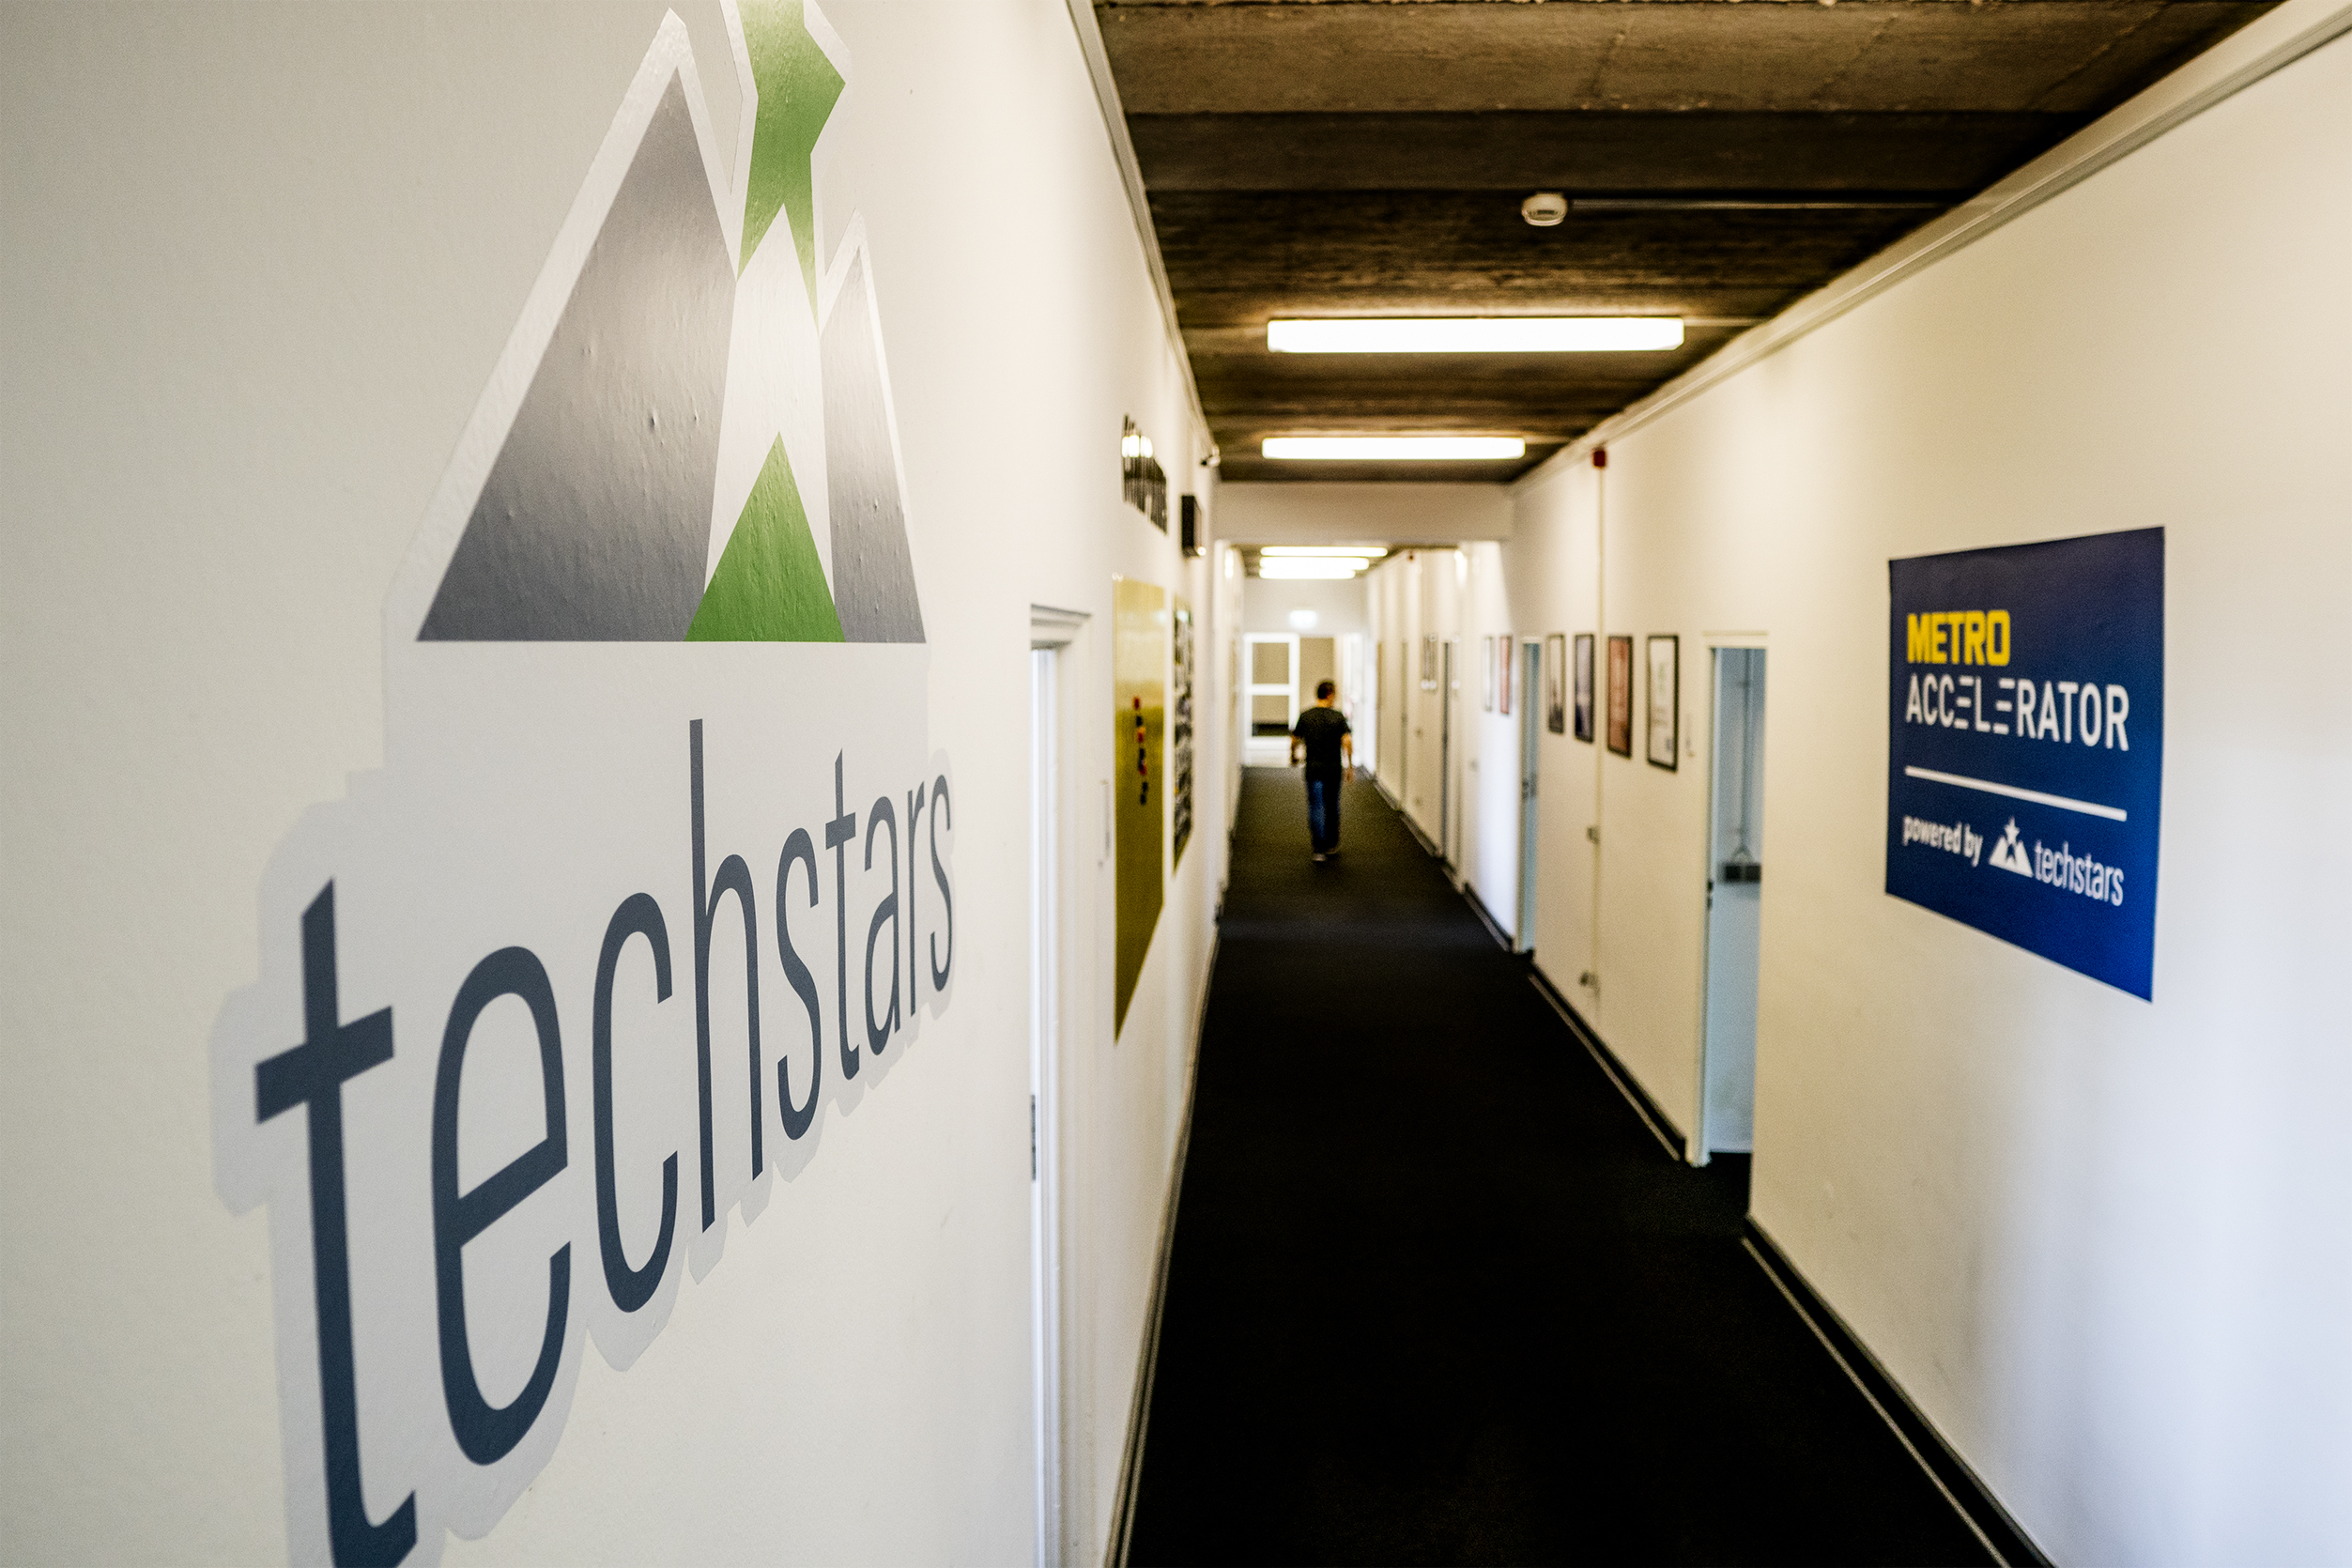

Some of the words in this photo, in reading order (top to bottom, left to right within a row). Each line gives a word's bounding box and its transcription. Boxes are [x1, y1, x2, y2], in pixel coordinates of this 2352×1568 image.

[1907, 610, 2011, 666] METRO
[1905, 673, 2130, 751] ACCELERATOR
[1902, 815, 1962, 854] powered
[1963, 823, 1984, 868] by
[2035, 839, 2125, 907] techstars
[255, 719, 953, 1568] techstars
